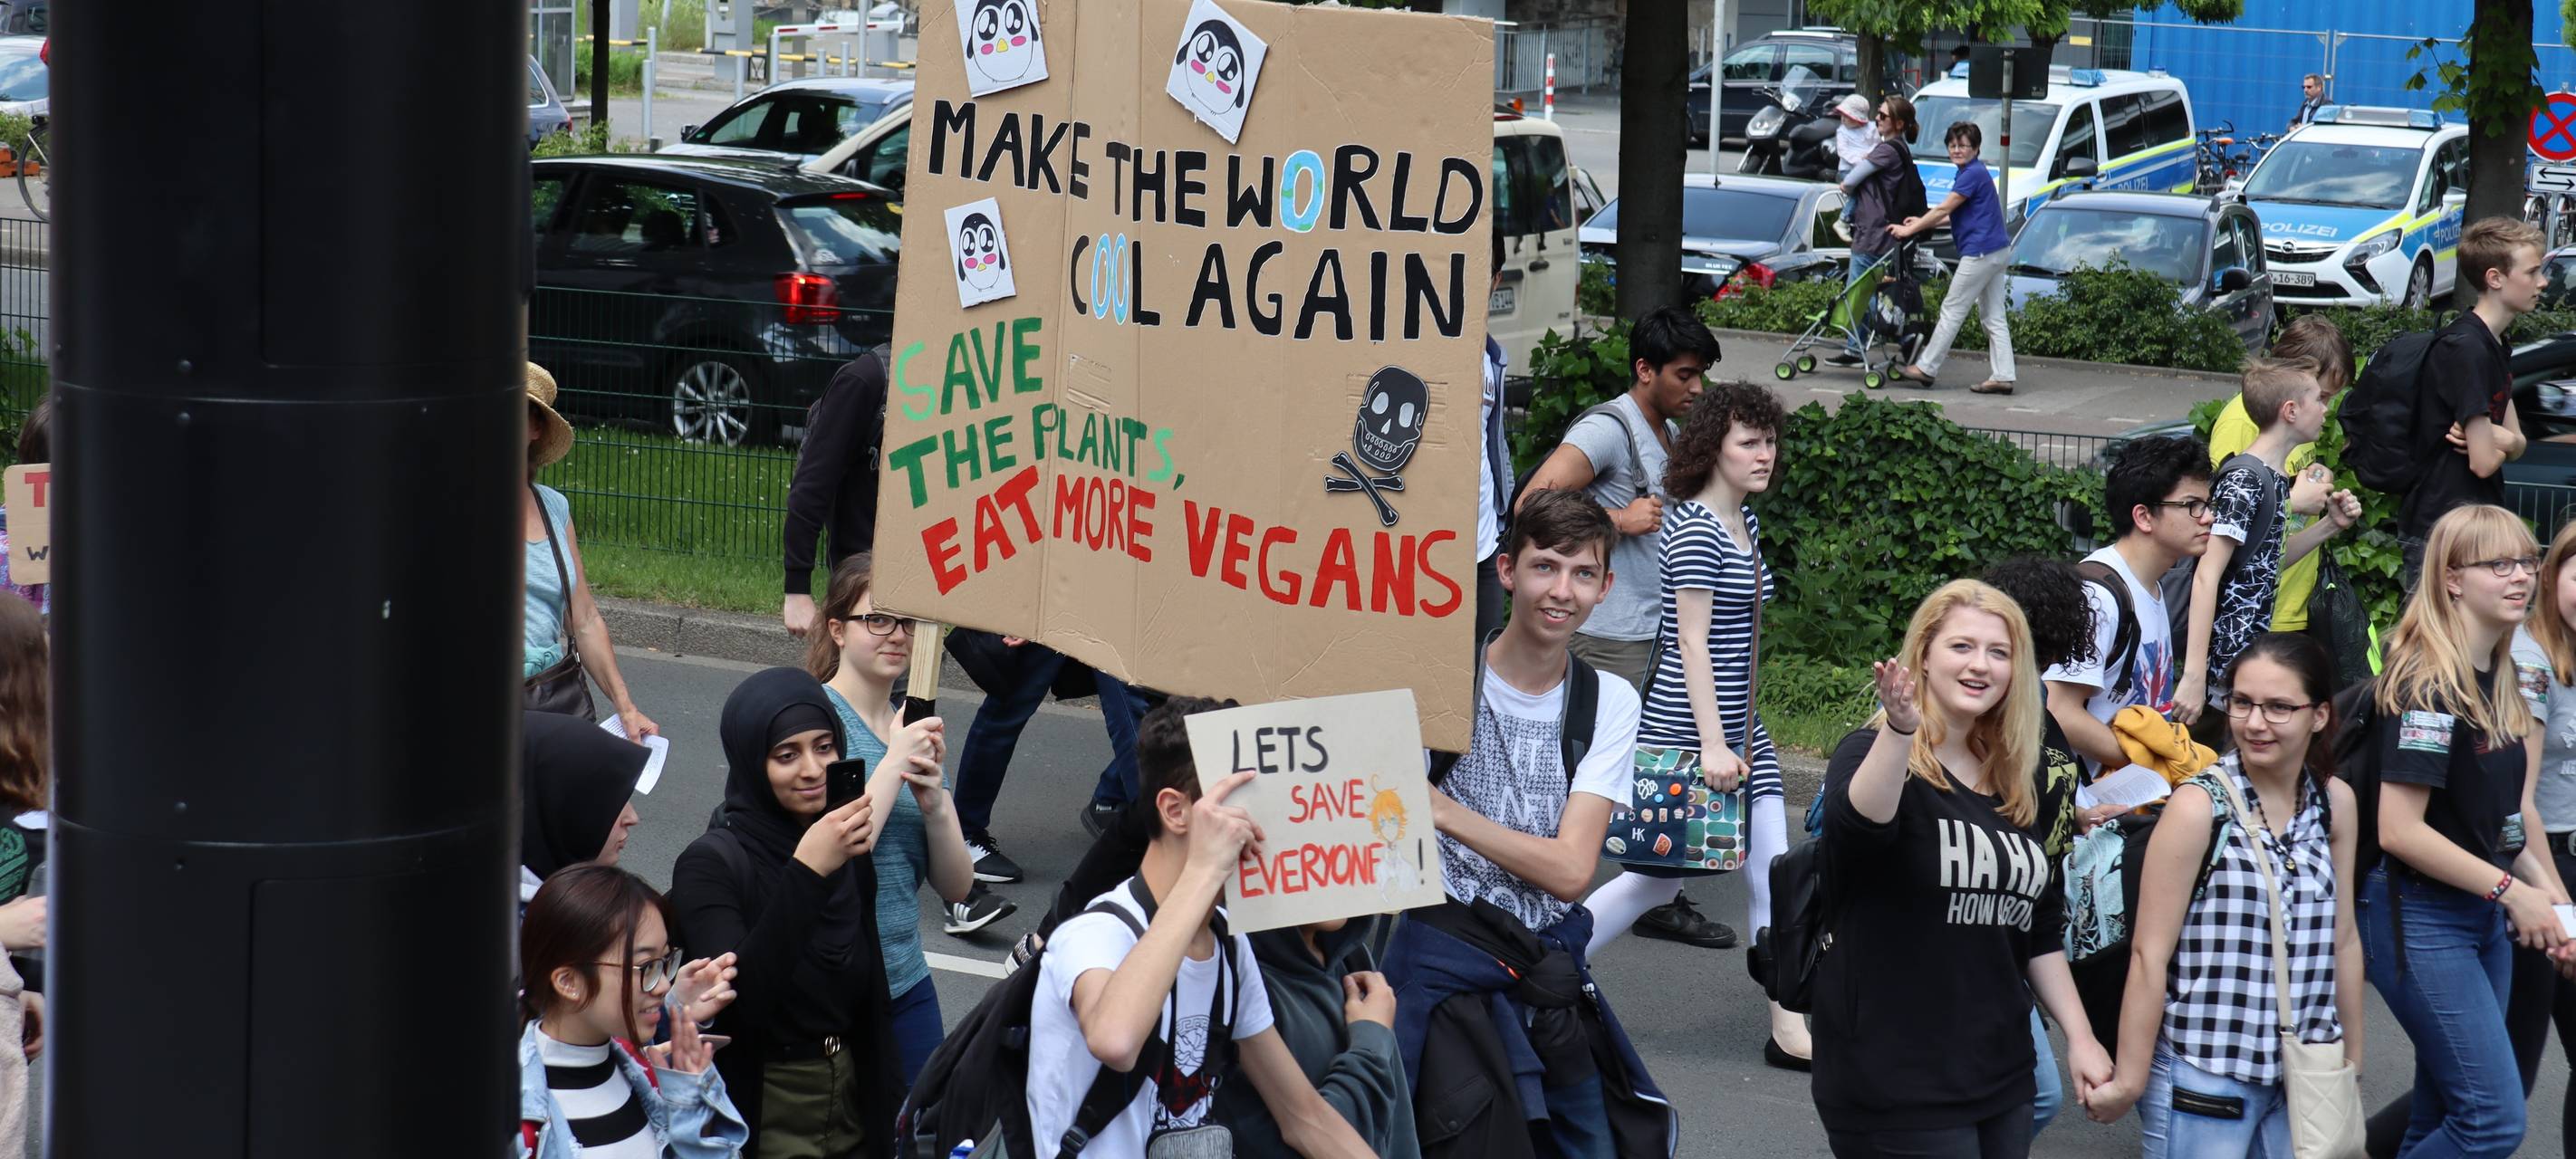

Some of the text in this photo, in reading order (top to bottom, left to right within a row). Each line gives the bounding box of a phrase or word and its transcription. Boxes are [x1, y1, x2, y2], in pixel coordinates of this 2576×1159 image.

[928, 100, 1484, 234] MAKE THE WORLD
[2261, 223, 2339, 237] POLIZEI
[1071, 232, 1466, 341] COOL AGAIN
[896, 317, 1043, 421] SAVE
[889, 403, 1186, 509] THE PLANTS,
[921, 466, 1463, 618] EAT MORE VEGANS
[1233, 725, 1329, 774] LETS
[1289, 779, 1369, 823] SAVE
[1938, 819, 2048, 900] HA HA
[1946, 892, 1996, 925] HOW
